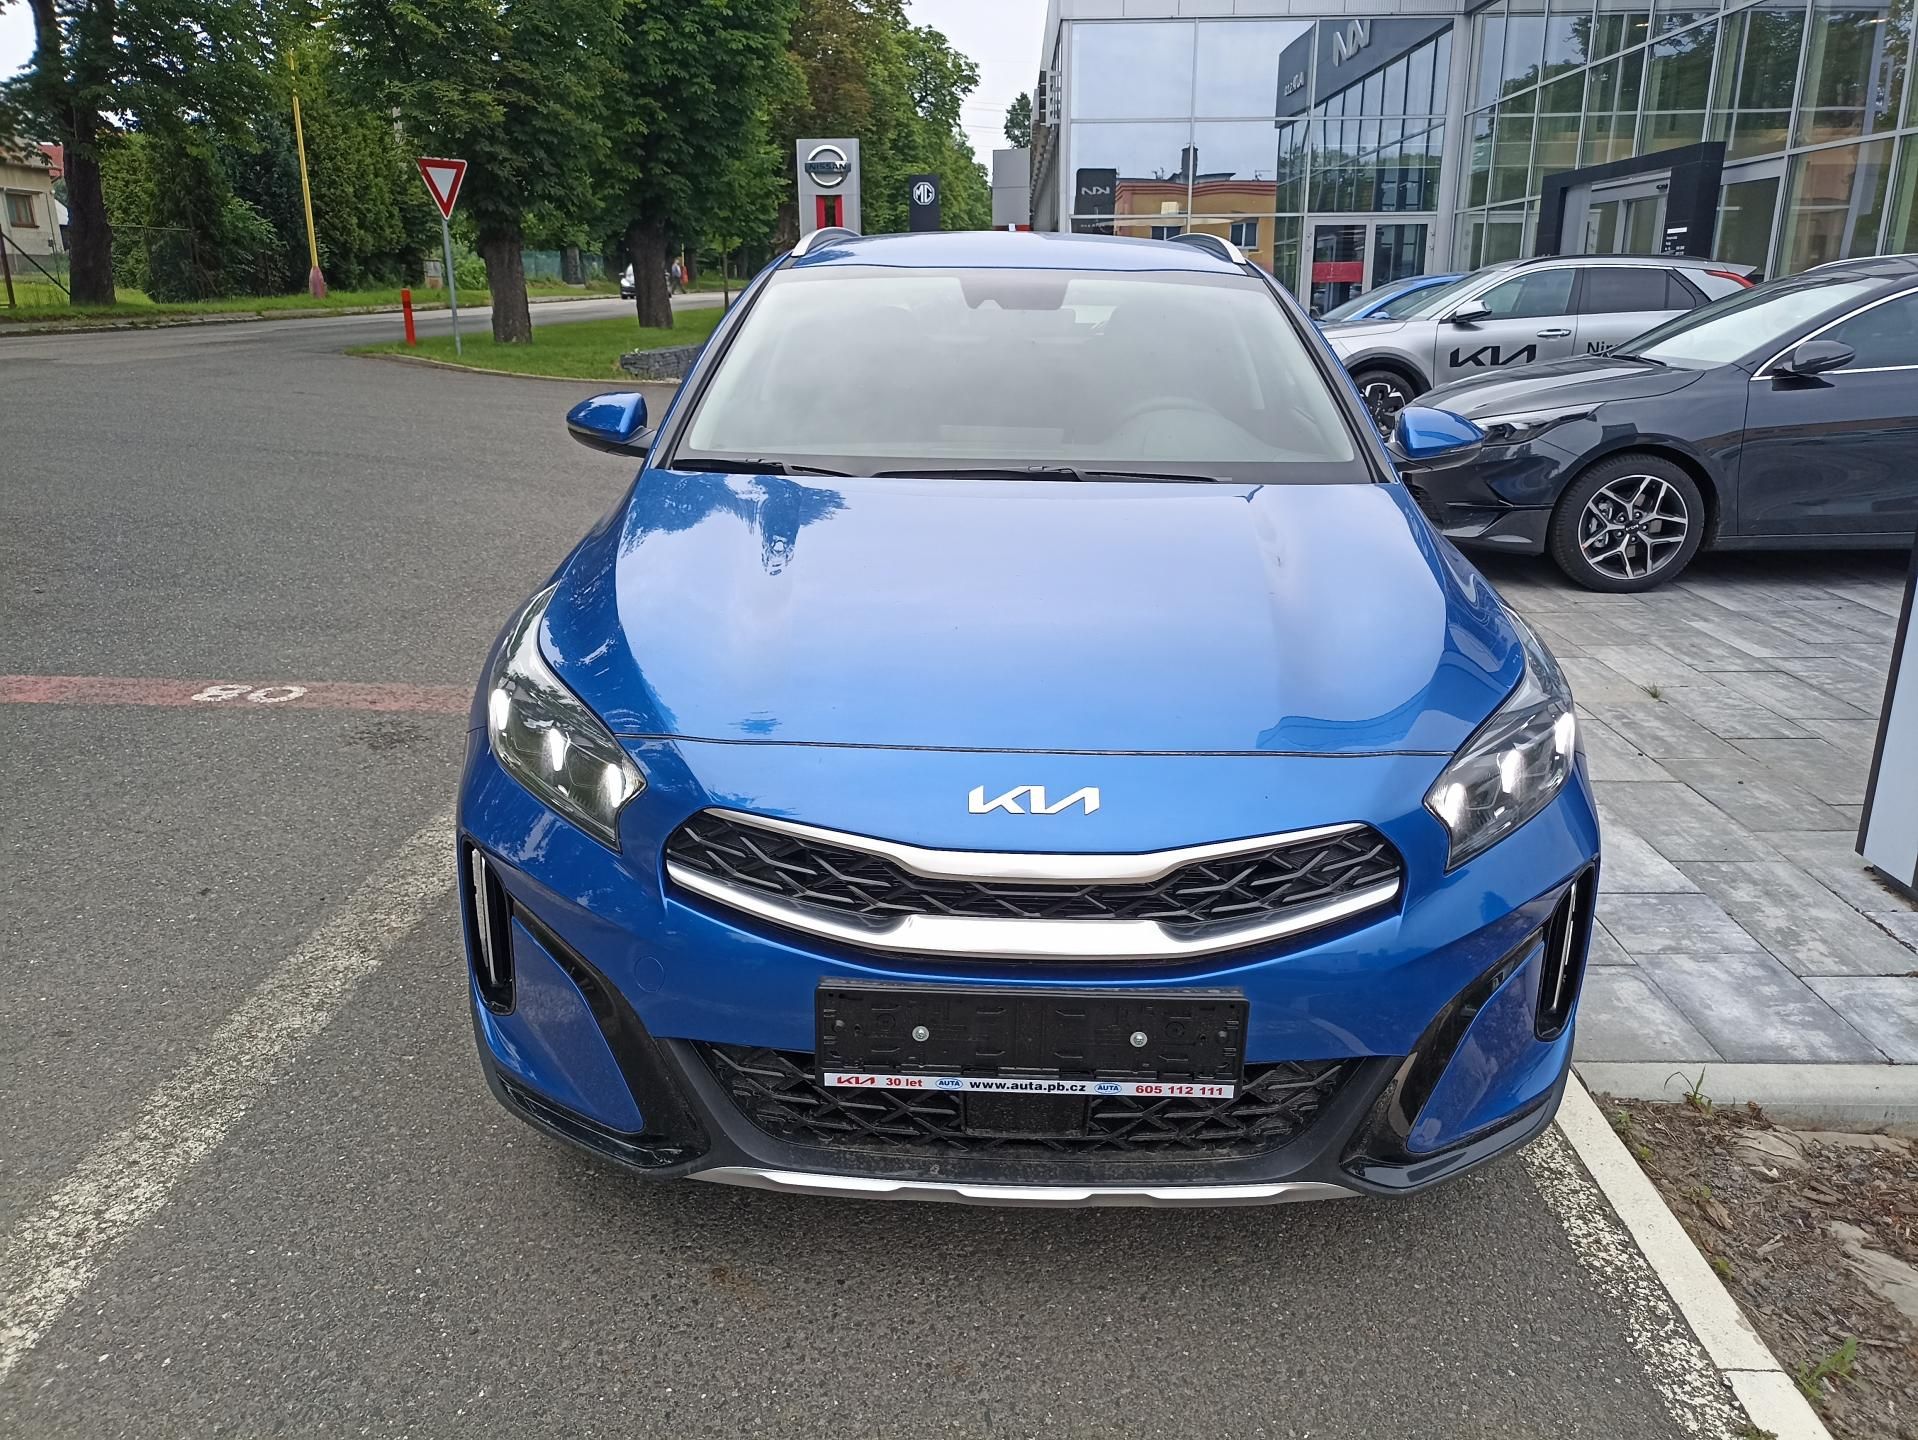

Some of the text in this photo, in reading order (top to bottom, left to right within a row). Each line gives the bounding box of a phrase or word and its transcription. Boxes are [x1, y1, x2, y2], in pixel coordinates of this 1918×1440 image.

[809, 162, 847, 171] NISSAN
[914, 184, 933, 203] MG
[1449, 344, 1537, 368] KIA
[968, 785, 1100, 815] KIA
[837, 1076, 876, 1085] KIA
[886, 1077, 902, 1087] 30
[905, 1078, 923, 1088] let
[969, 1081, 1087, 1093] www.auta.pb.cz
[1097, 1084, 1119, 1092] AUTA
[1135, 1085, 1163, 1094] 605
[1168, 1086, 1194, 1095] 112
[1199, 1087, 1223, 1096] 111
